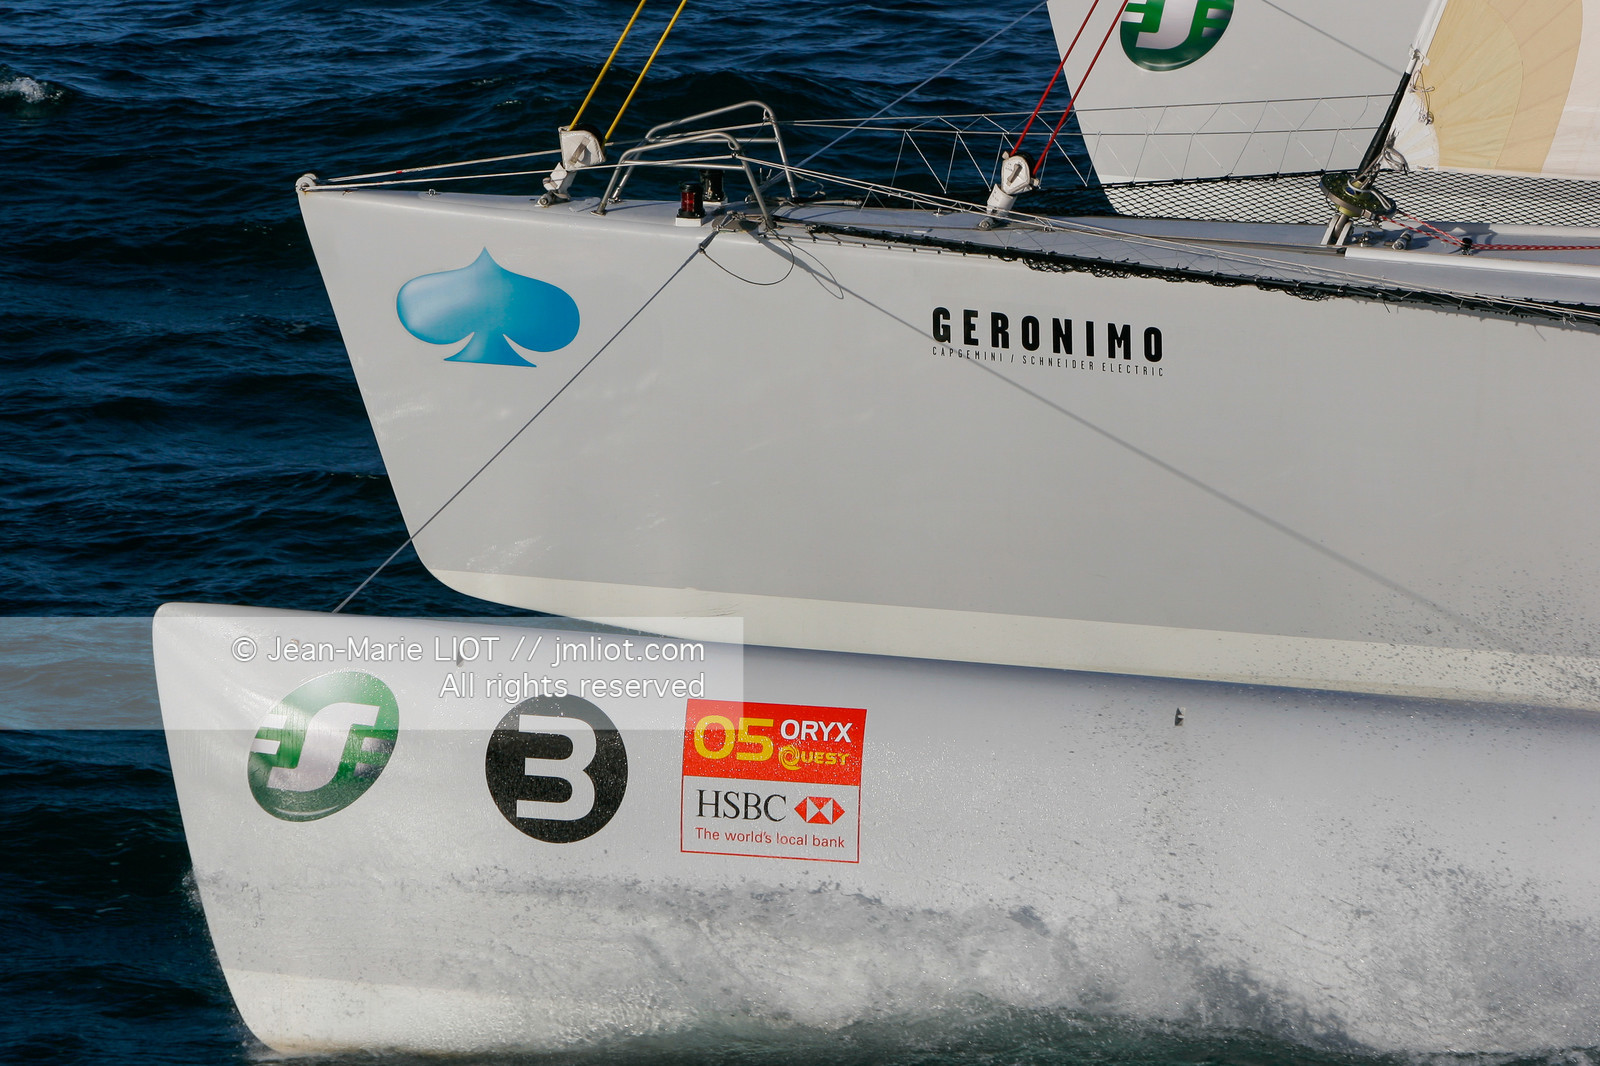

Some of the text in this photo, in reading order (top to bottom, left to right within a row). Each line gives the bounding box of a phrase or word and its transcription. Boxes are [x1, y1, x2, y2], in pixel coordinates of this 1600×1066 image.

[932, 306, 1163, 363] GERONIMO
[932, 346, 1004, 363] CAPGEMINI
[1022, 355, 1095, 371] SCHNEIDER
[1102, 362, 1164, 377] ELECTRIC
[693, 715, 774, 762] 05
[780, 719, 853, 743] ORYX
[516, 714, 598, 822] 3
[778, 744, 850, 770] QUEST
[696, 789, 786, 822] HSBC
[695, 827, 845, 848] The world's local bank
